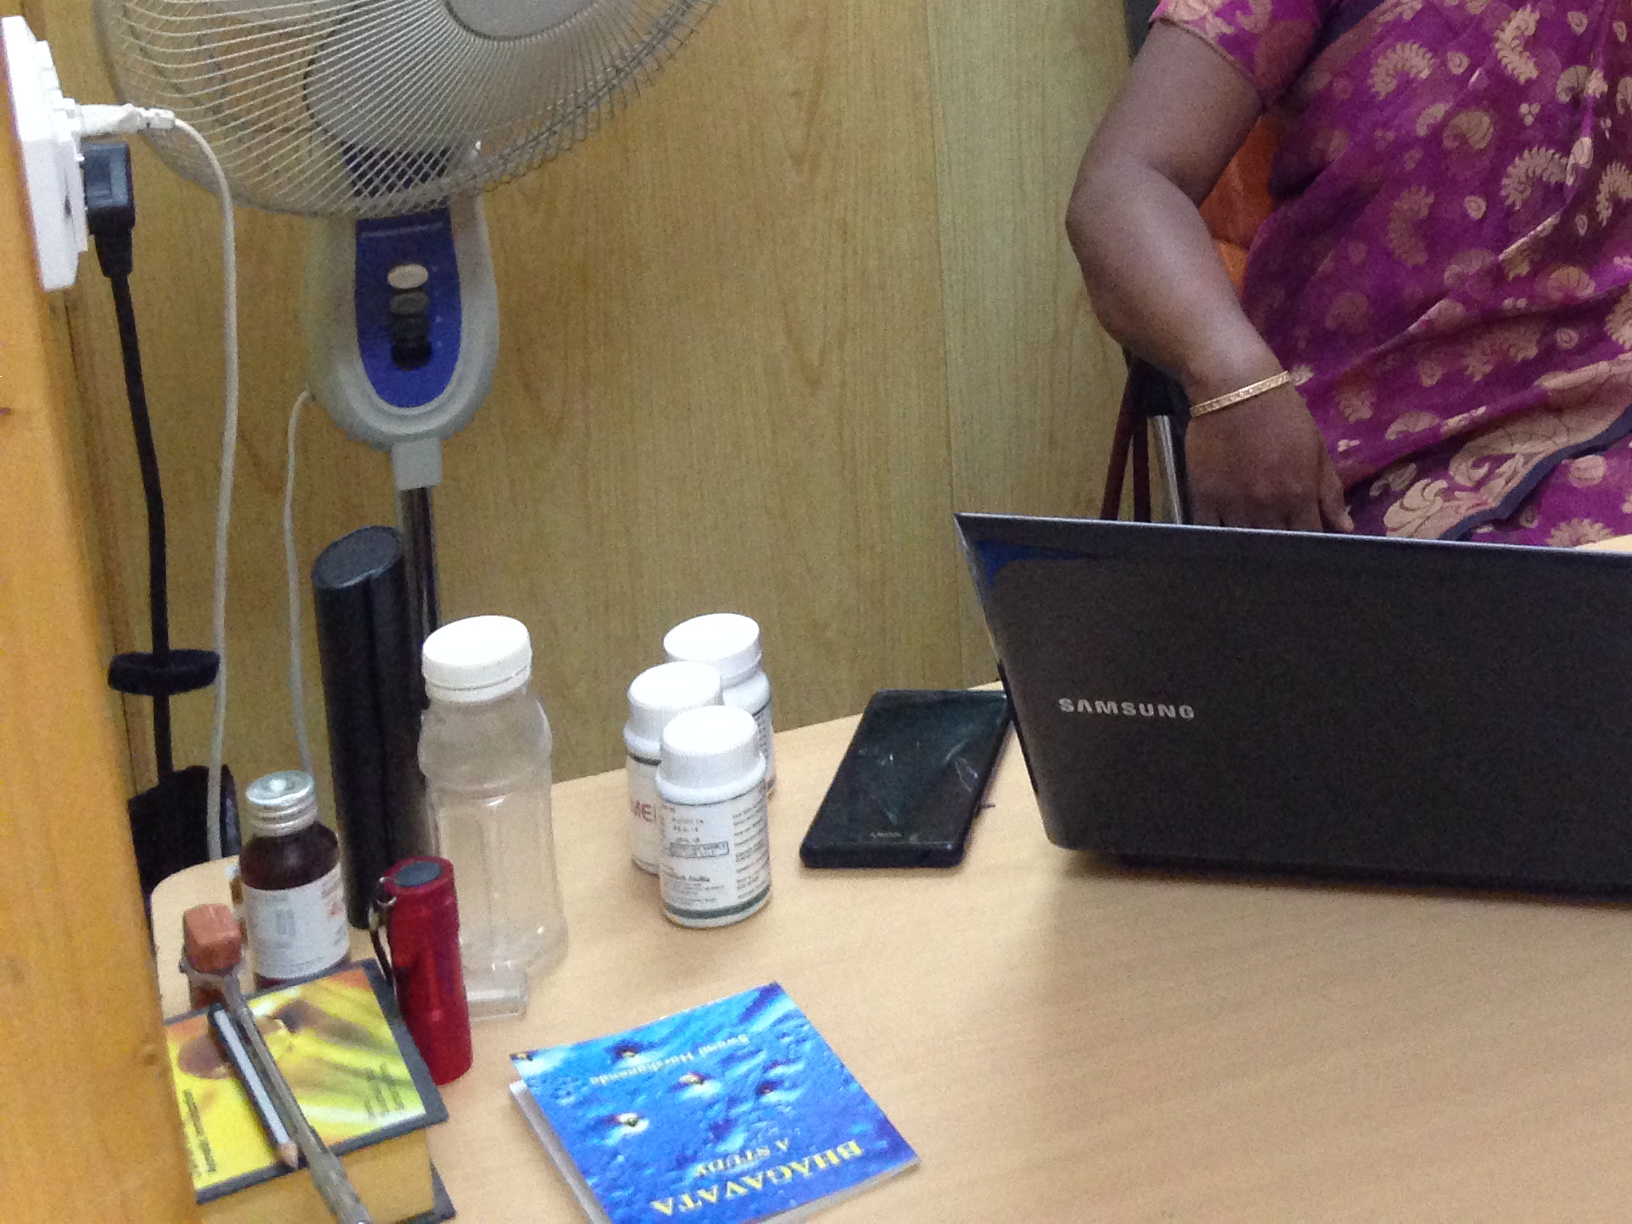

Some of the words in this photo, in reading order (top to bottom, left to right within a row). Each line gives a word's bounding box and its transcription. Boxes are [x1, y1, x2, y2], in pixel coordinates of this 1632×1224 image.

[1058, 698, 1195, 719] SAMSUNG
[774, 1138, 790, 1152] A
[695, 1145, 771, 1176] STUDY
